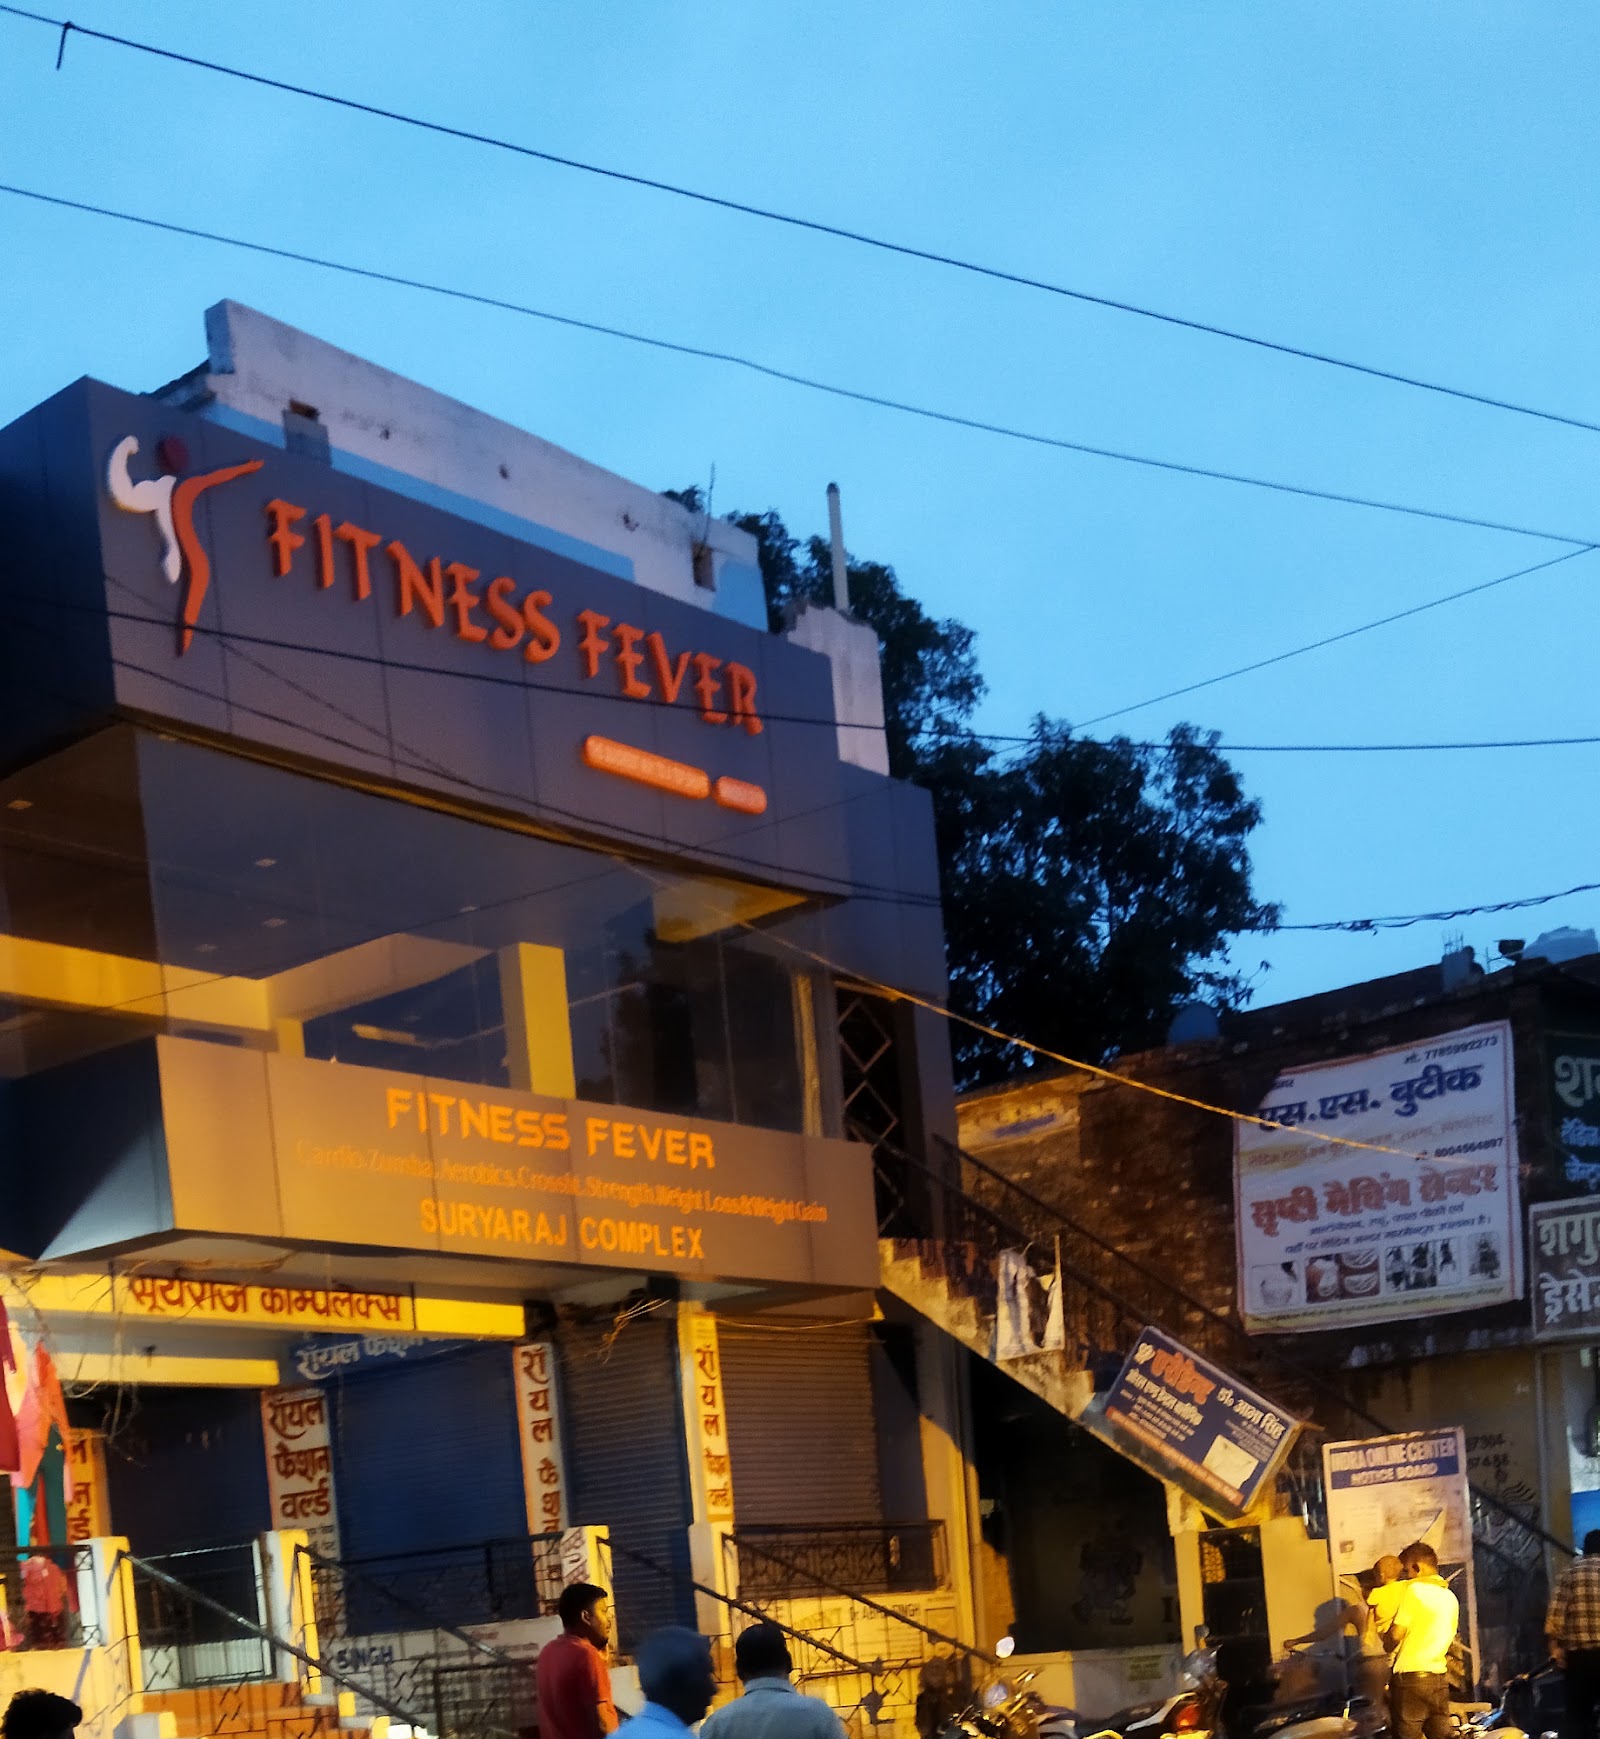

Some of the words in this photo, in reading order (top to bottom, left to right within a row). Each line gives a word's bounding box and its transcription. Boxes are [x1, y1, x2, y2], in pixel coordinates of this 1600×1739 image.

[265, 498, 562, 664] FITNESS
[577, 608, 765, 736] FEVER
[386, 1087, 571, 1151] FITNESS
[586, 1117, 716, 1170] FEVER
[420, 1198, 568, 1246] SURYARAJ
[580, 1217, 705, 1259] COMPLEX
[1537, 1211, 1600, 1267] शगु
[268, 1395, 325, 1440] रॉयल
[273, 1441, 332, 1482] फैशन
[1407, 1437, 1456, 1461] CENTER
[1351, 1467, 1395, 1486] NOTICE
[1395, 1462, 1439, 1480] BOARD
[280, 1478, 331, 1519] वर्ल्ड
[337, 1646, 394, 1669] SINGH
